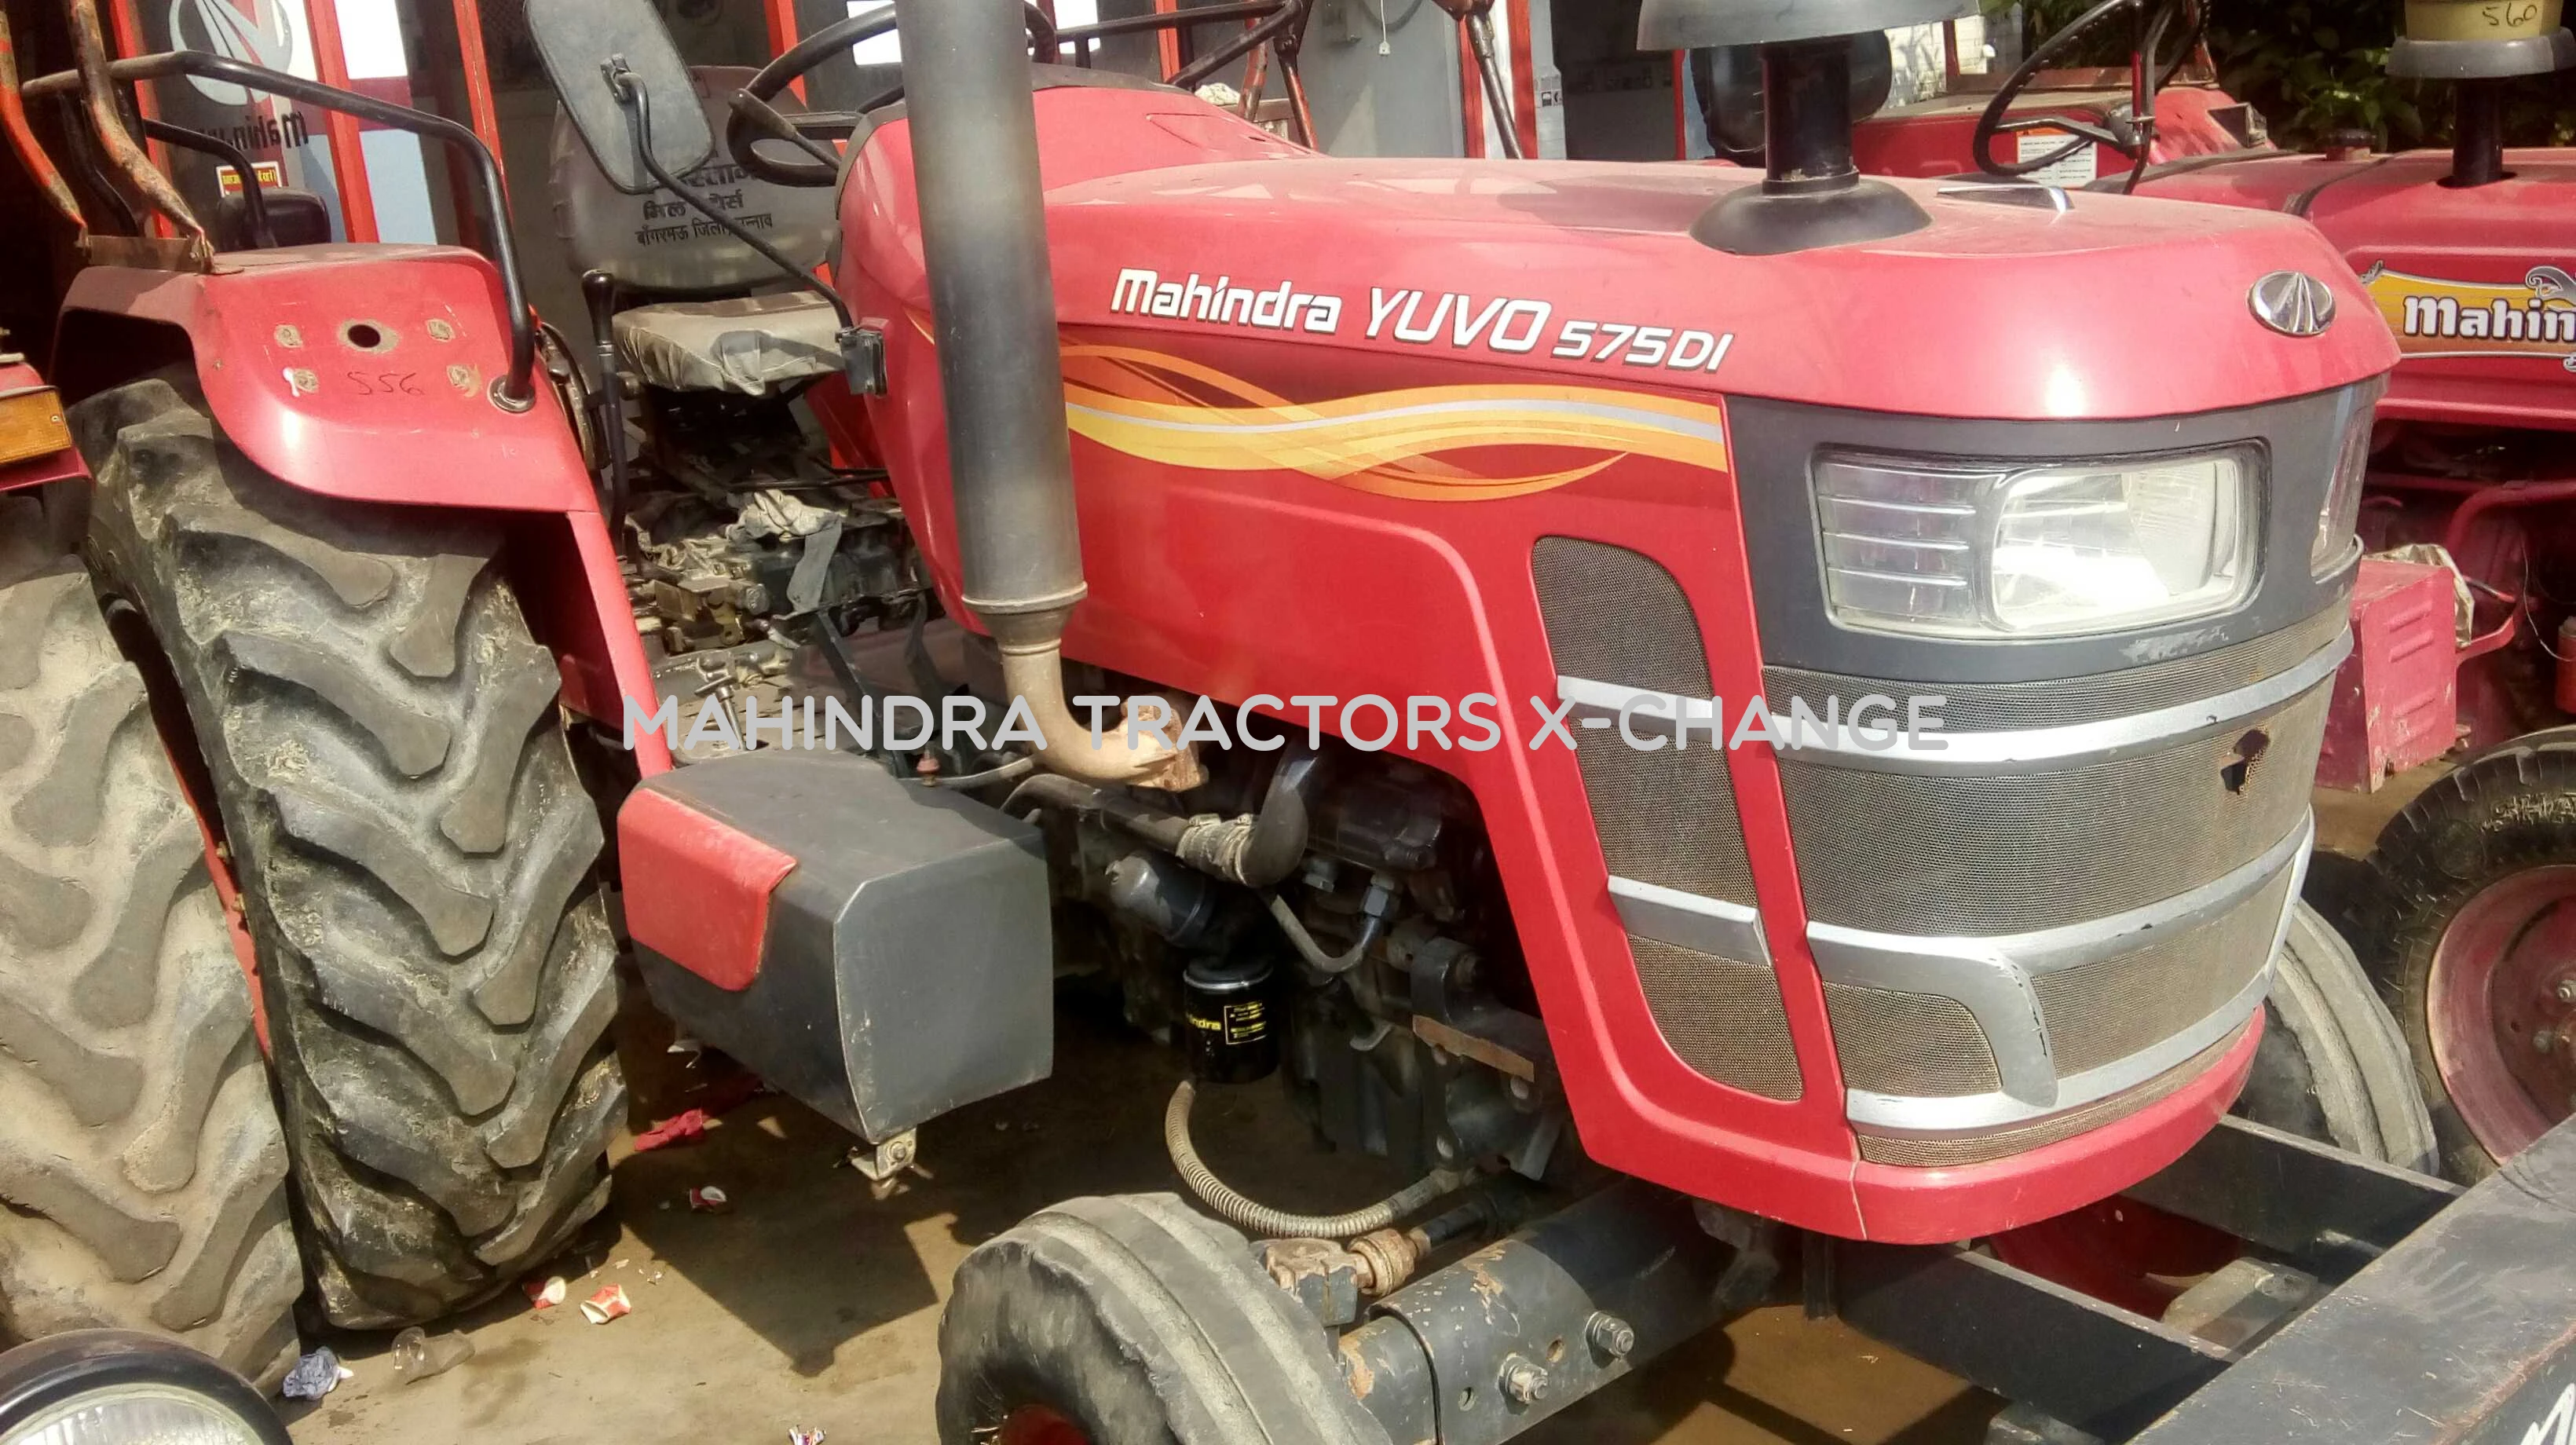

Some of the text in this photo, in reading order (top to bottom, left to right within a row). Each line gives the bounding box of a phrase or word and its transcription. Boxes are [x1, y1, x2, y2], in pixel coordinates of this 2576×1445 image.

[2482, 2, 2538, 27] 560
[1110, 267, 1736, 374] Mahindra YUVO 575DI
